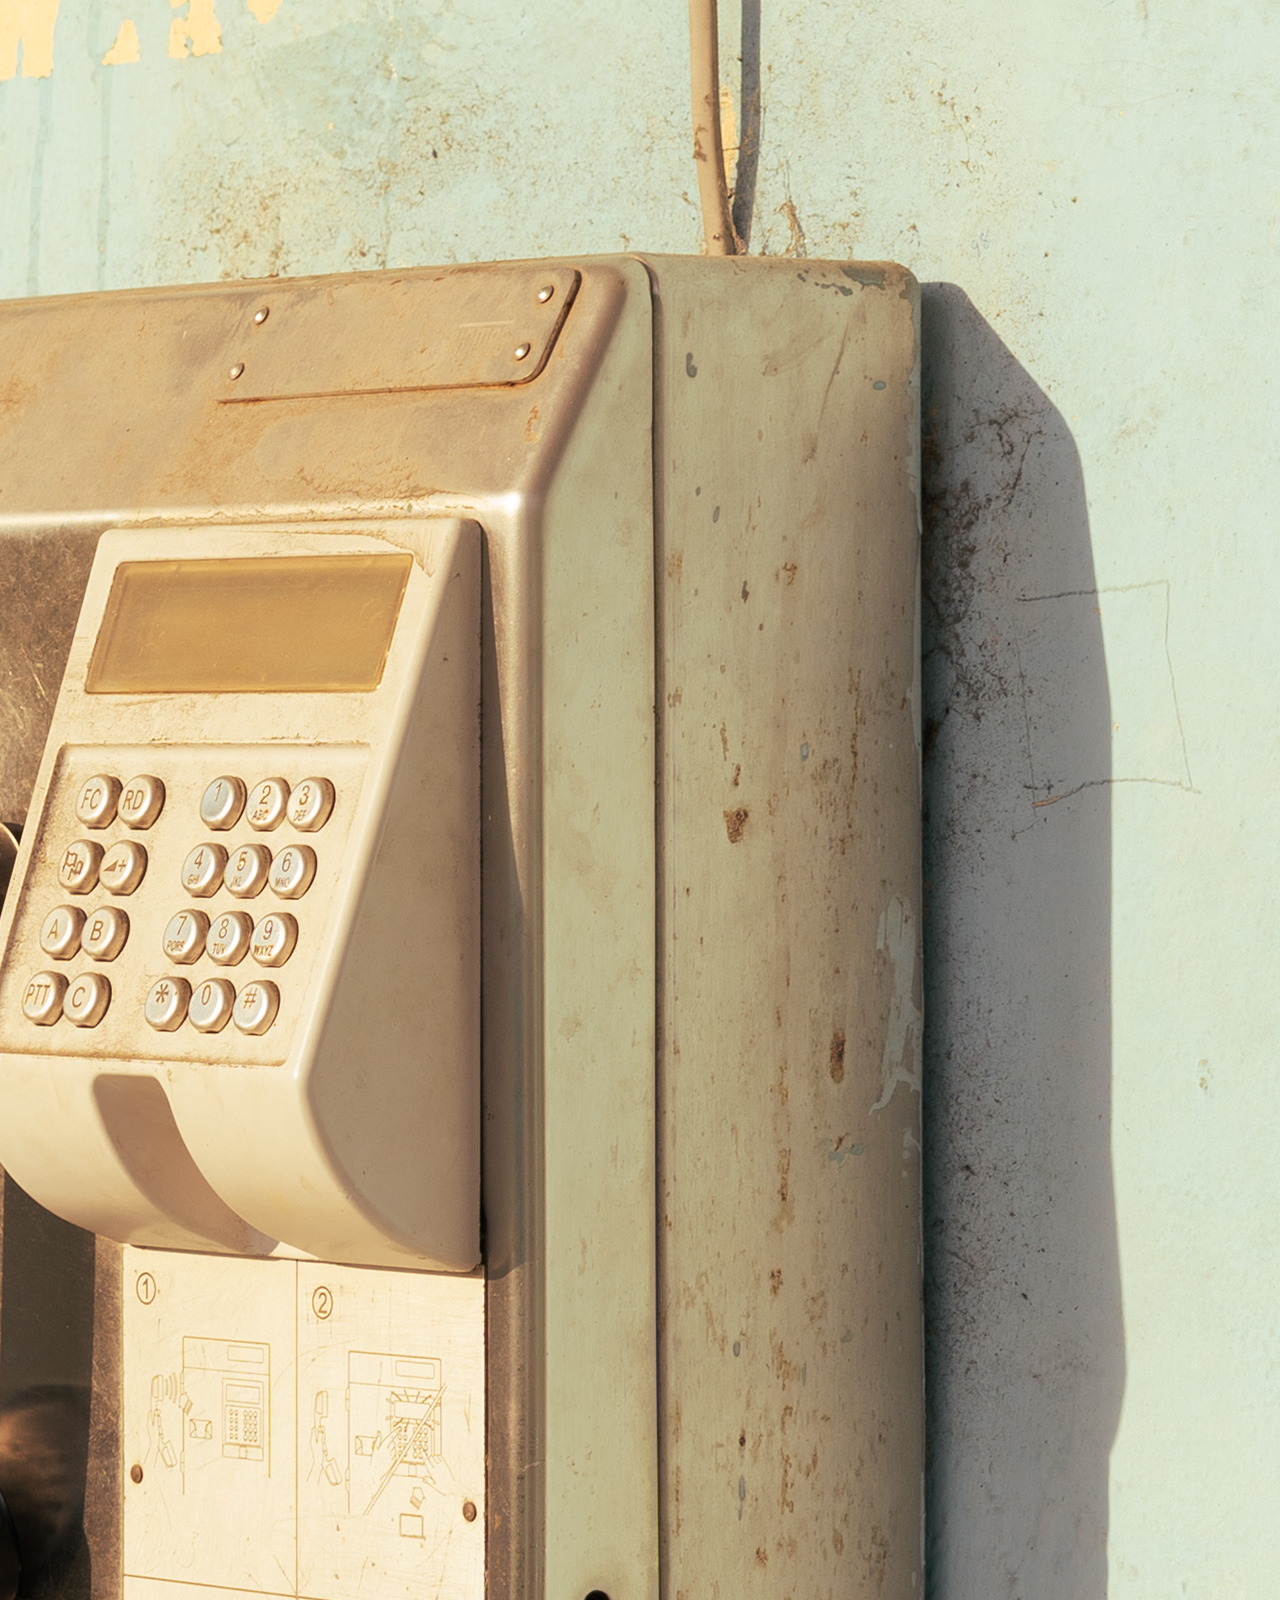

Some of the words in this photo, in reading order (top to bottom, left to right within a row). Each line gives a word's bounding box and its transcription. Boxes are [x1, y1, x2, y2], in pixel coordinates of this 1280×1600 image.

[80, 788, 102, 810] FC
[121, 789, 145, 811] RD
[214, 782, 223, 802] 1
[259, 785, 272, 805] 2
[299, 785, 310, 806] 3
[252, 809, 269, 821] ABC
[193, 849, 204, 870] 4
[236, 851, 248, 872] 5
[281, 851, 293, 873] 6
[47, 918, 59, 940] A
[89, 920, 104, 942] B
[176, 915, 188, 936] 7
[218, 918, 230, 939] 8
[262, 919, 274, 941] 9
[212, 942, 227, 955] TUV
[254, 944, 274, 957] WXYZ
[24, 983, 51, 1006] PTT
[71, 986, 86, 1008] C
[201, 984, 212, 1006] 0
[243, 987, 258, 1009] #
